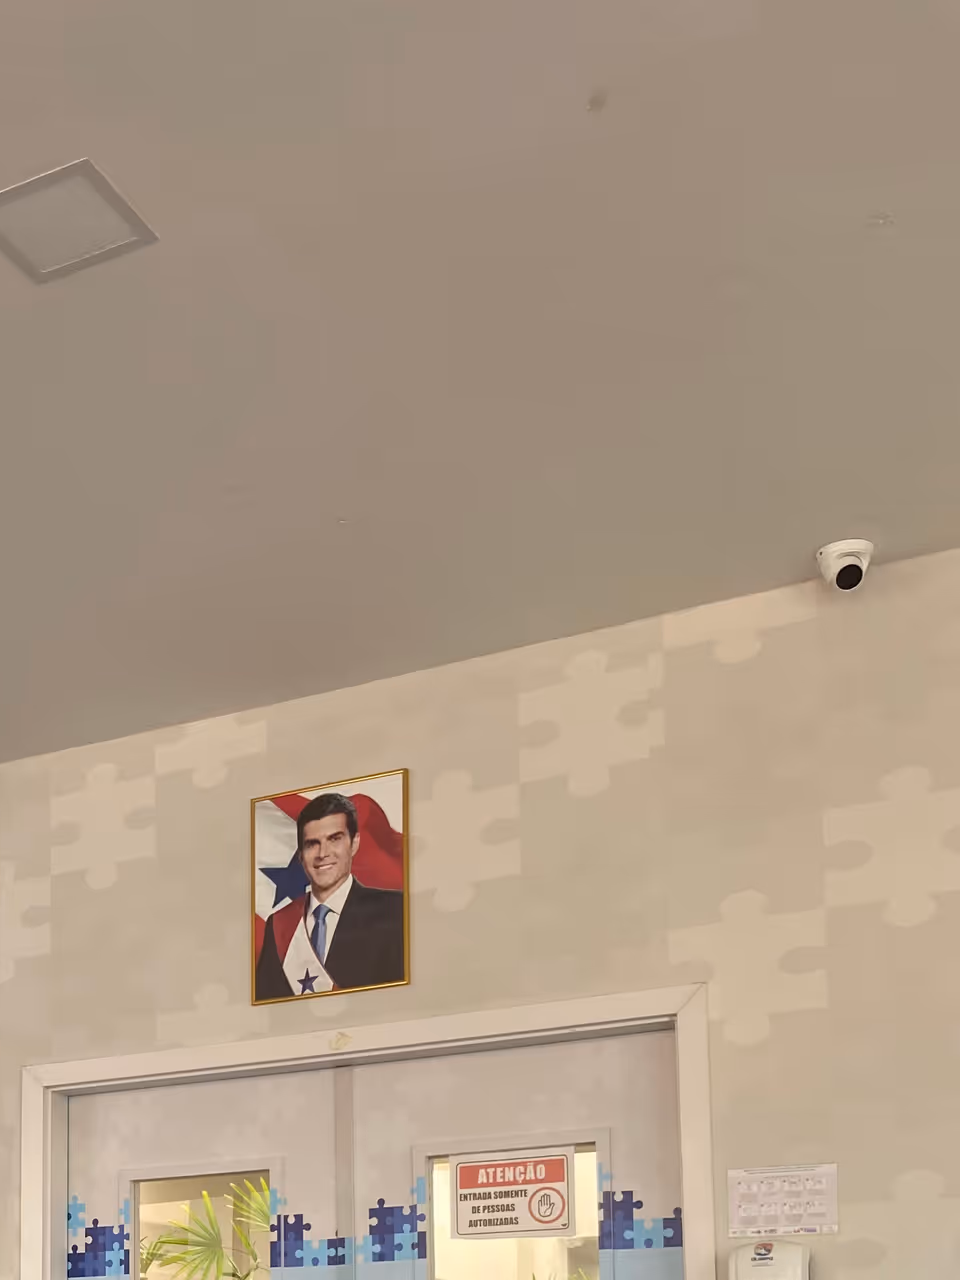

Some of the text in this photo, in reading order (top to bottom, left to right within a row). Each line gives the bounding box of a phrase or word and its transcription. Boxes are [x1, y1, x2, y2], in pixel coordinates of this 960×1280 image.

[477, 1162, 546, 1184] ATENÇÃO
[459, 1189, 528, 1202] ENTRADA SOMENTE
[471, 1203, 515, 1214] DE PESSOAS
[468, 1217, 519, 1228] AUTORIZADAS
